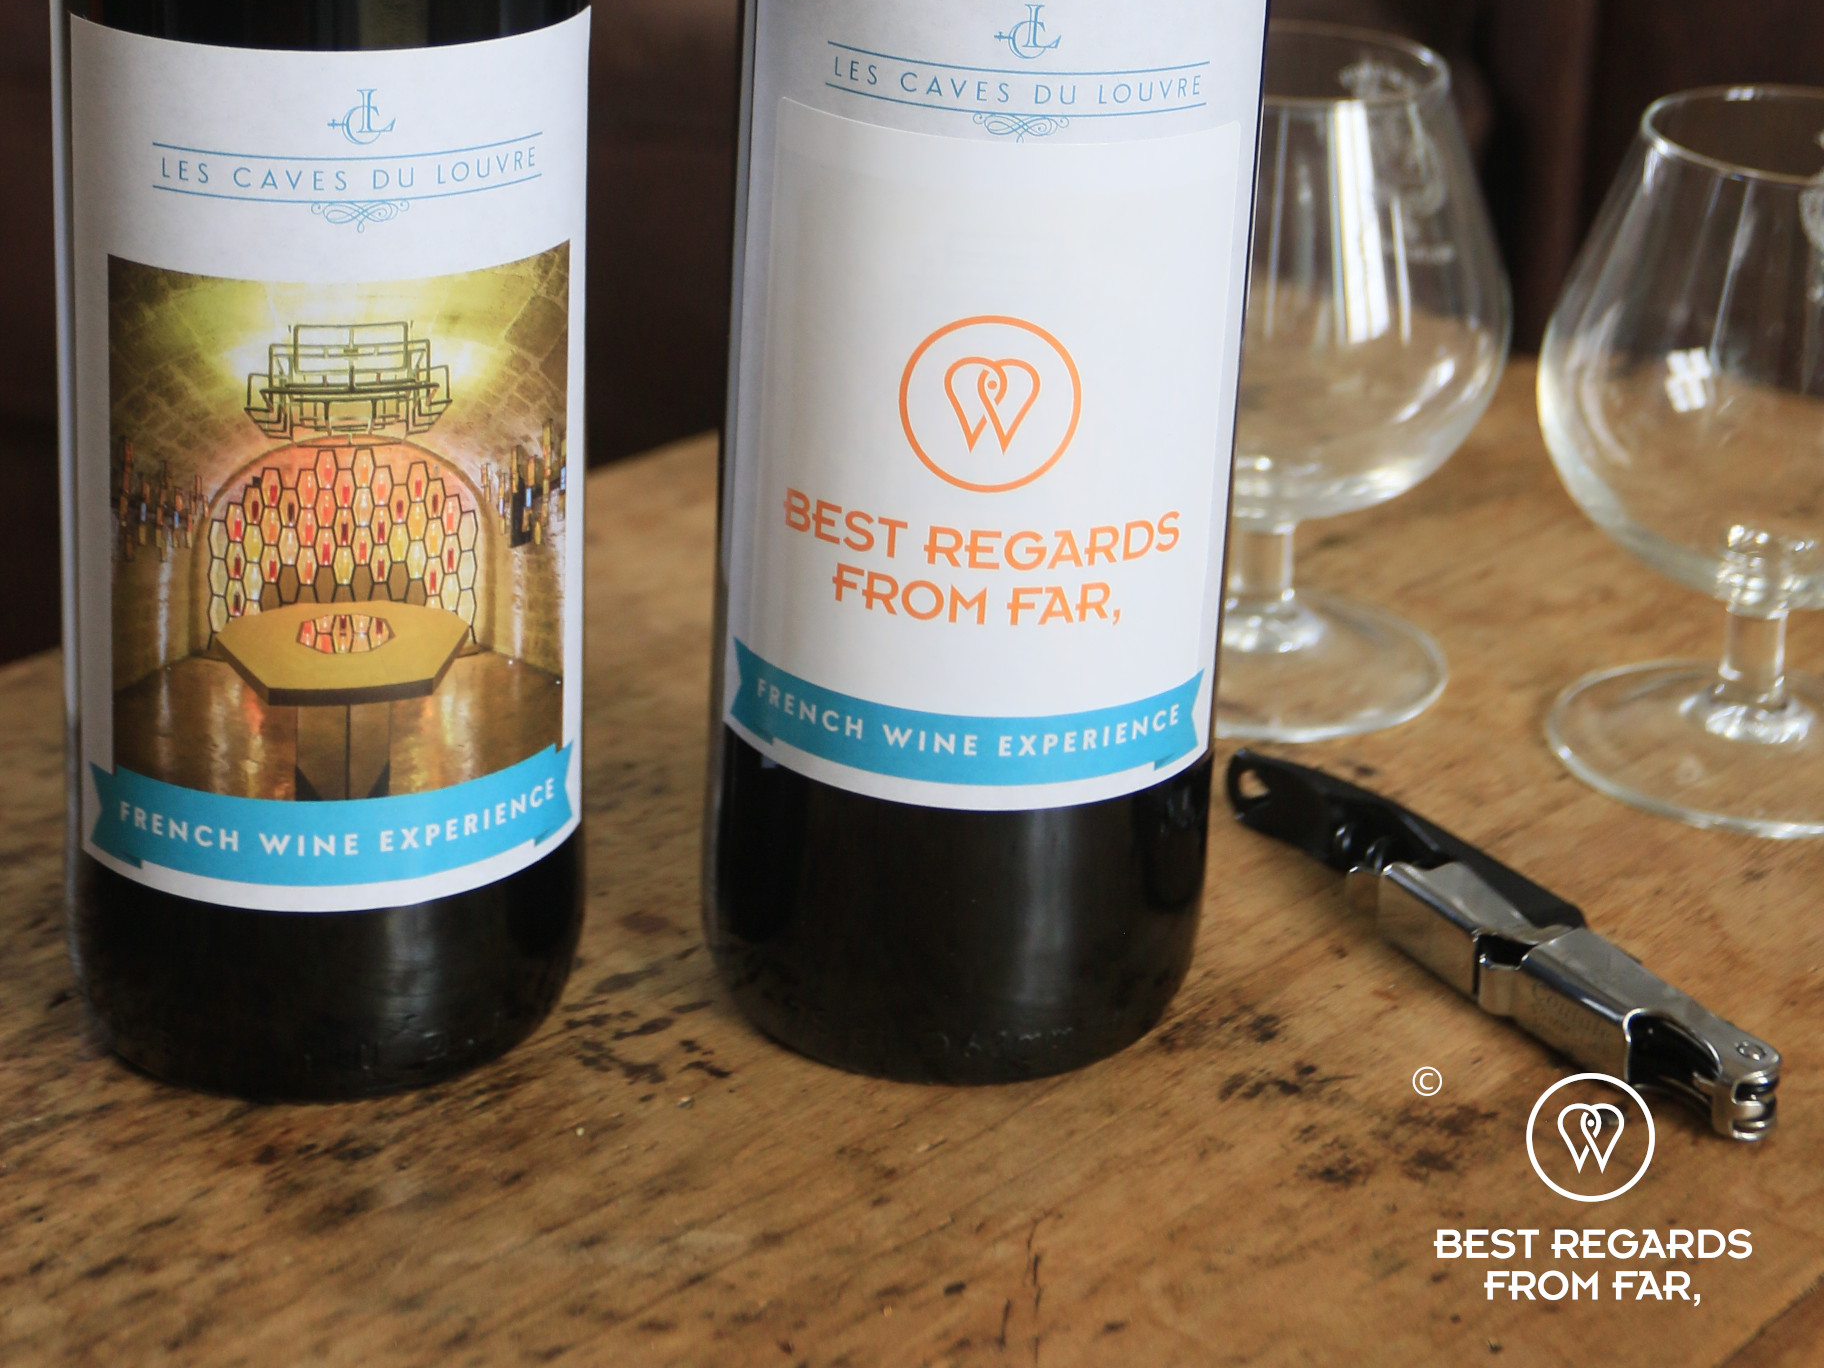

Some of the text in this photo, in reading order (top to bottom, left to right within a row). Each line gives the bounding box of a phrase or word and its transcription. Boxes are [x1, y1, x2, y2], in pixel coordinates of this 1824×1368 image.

[834, 56, 1200, 105] LES CAVES DU LOUVRE
[161, 146, 536, 191] LES CAVES DU LOUVRE
[783, 486, 1180, 571] BEST REGARDS
[832, 562, 1122, 627] FROM FAR,
[757, 678, 1180, 758] FRENCH WINE EXPERIENCE
[119, 776, 555, 857] FRENCH WINE EXPERIENCE
